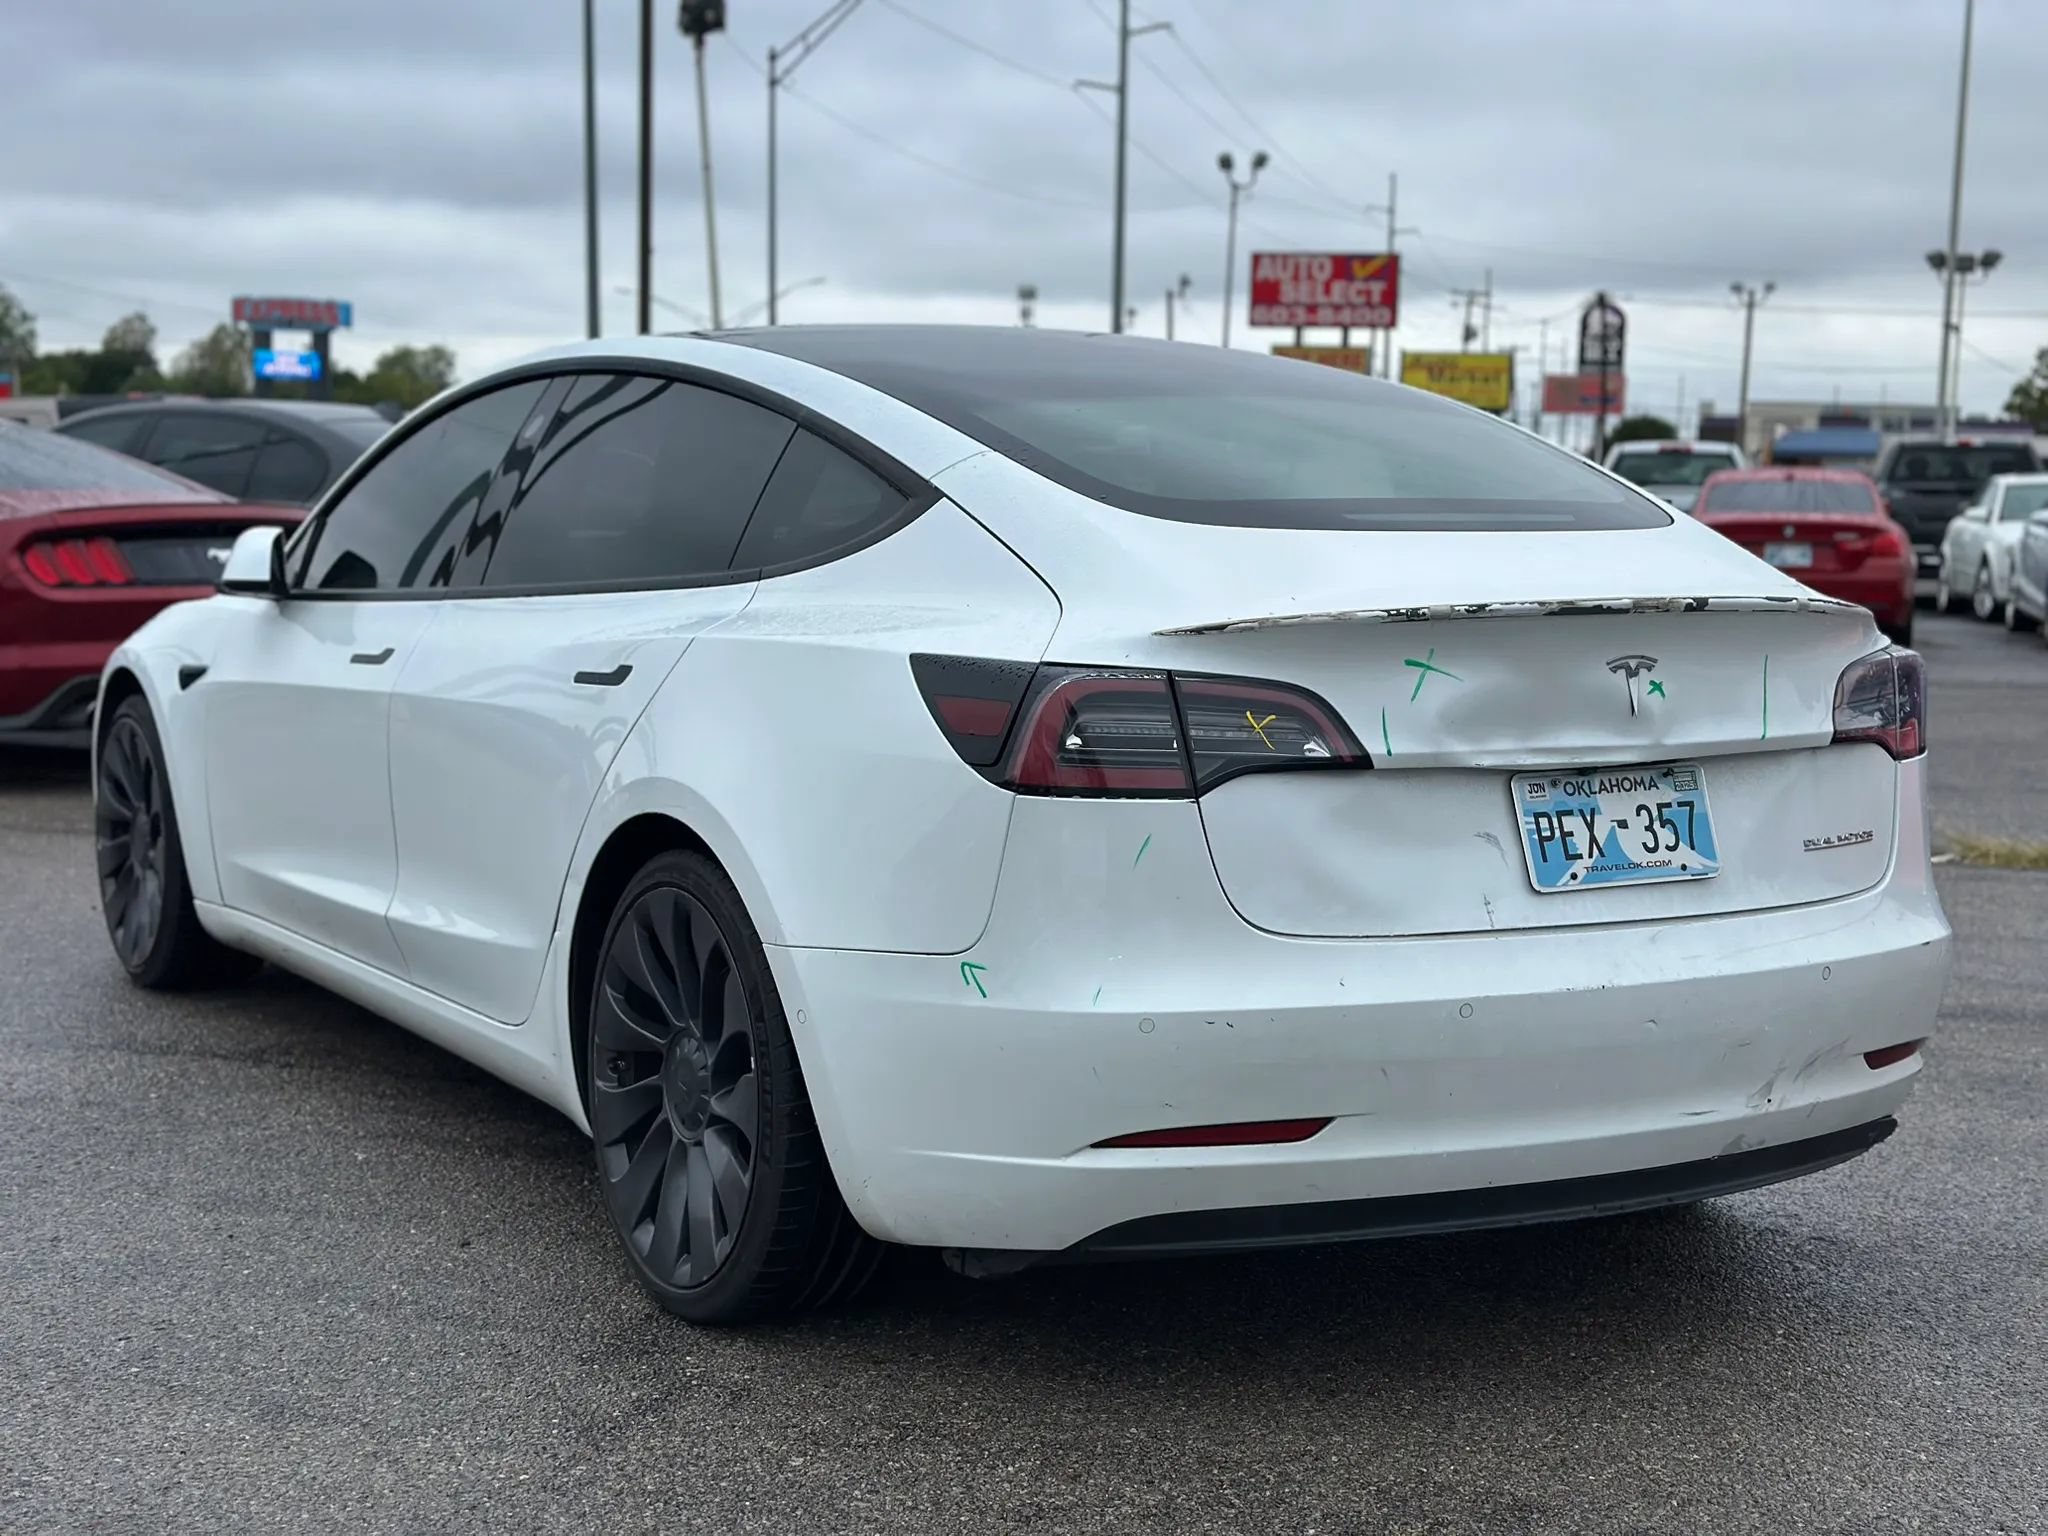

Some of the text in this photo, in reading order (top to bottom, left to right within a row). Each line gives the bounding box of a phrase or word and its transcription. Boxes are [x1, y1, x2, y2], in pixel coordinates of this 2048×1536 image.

[1255, 256, 1333, 281] AUTO
[1279, 279, 1388, 304] SELECT
[1563, 775, 1660, 798] OKLAHOMA
[1533, 800, 1696, 863] PEX 357
[1584, 859, 1673, 874] TRAVELOK.COM
